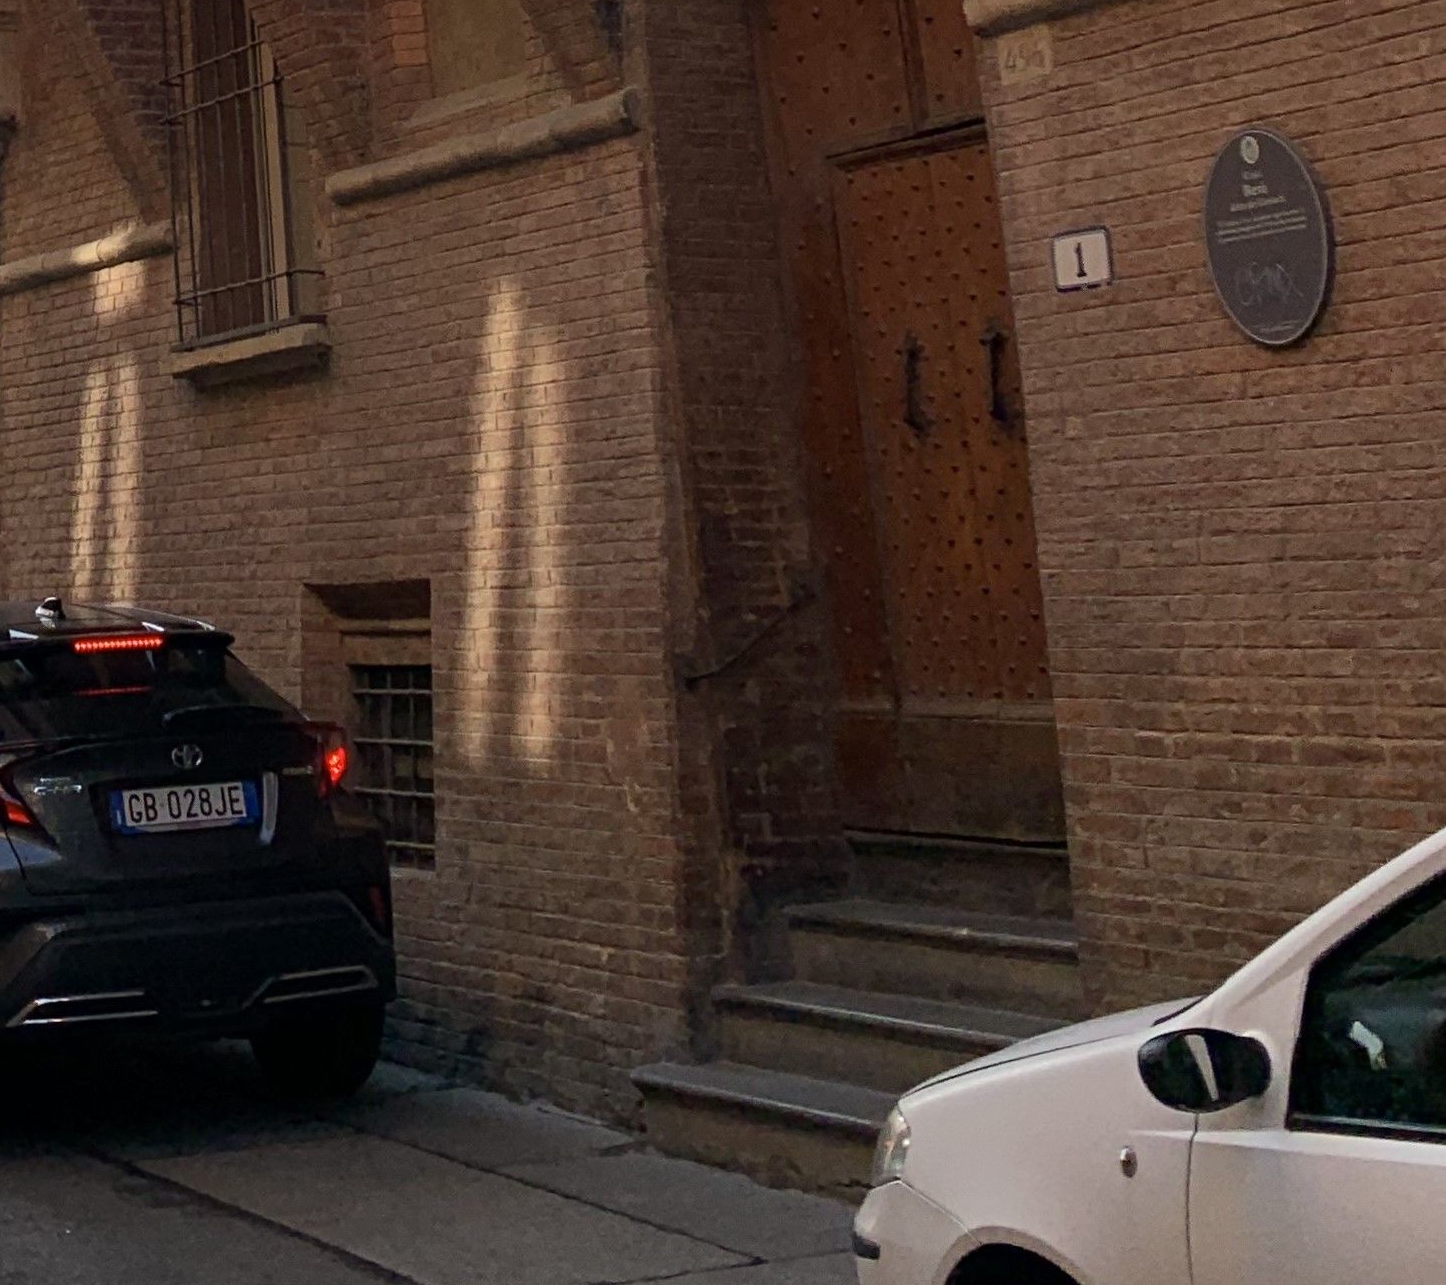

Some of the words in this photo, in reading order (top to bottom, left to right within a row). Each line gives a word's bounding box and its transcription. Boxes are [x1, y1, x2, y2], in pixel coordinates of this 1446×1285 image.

[1074, 242, 1087, 277] 1
[128, 793, 158, 824] GB
[168, 785, 244, 819] 028JE
